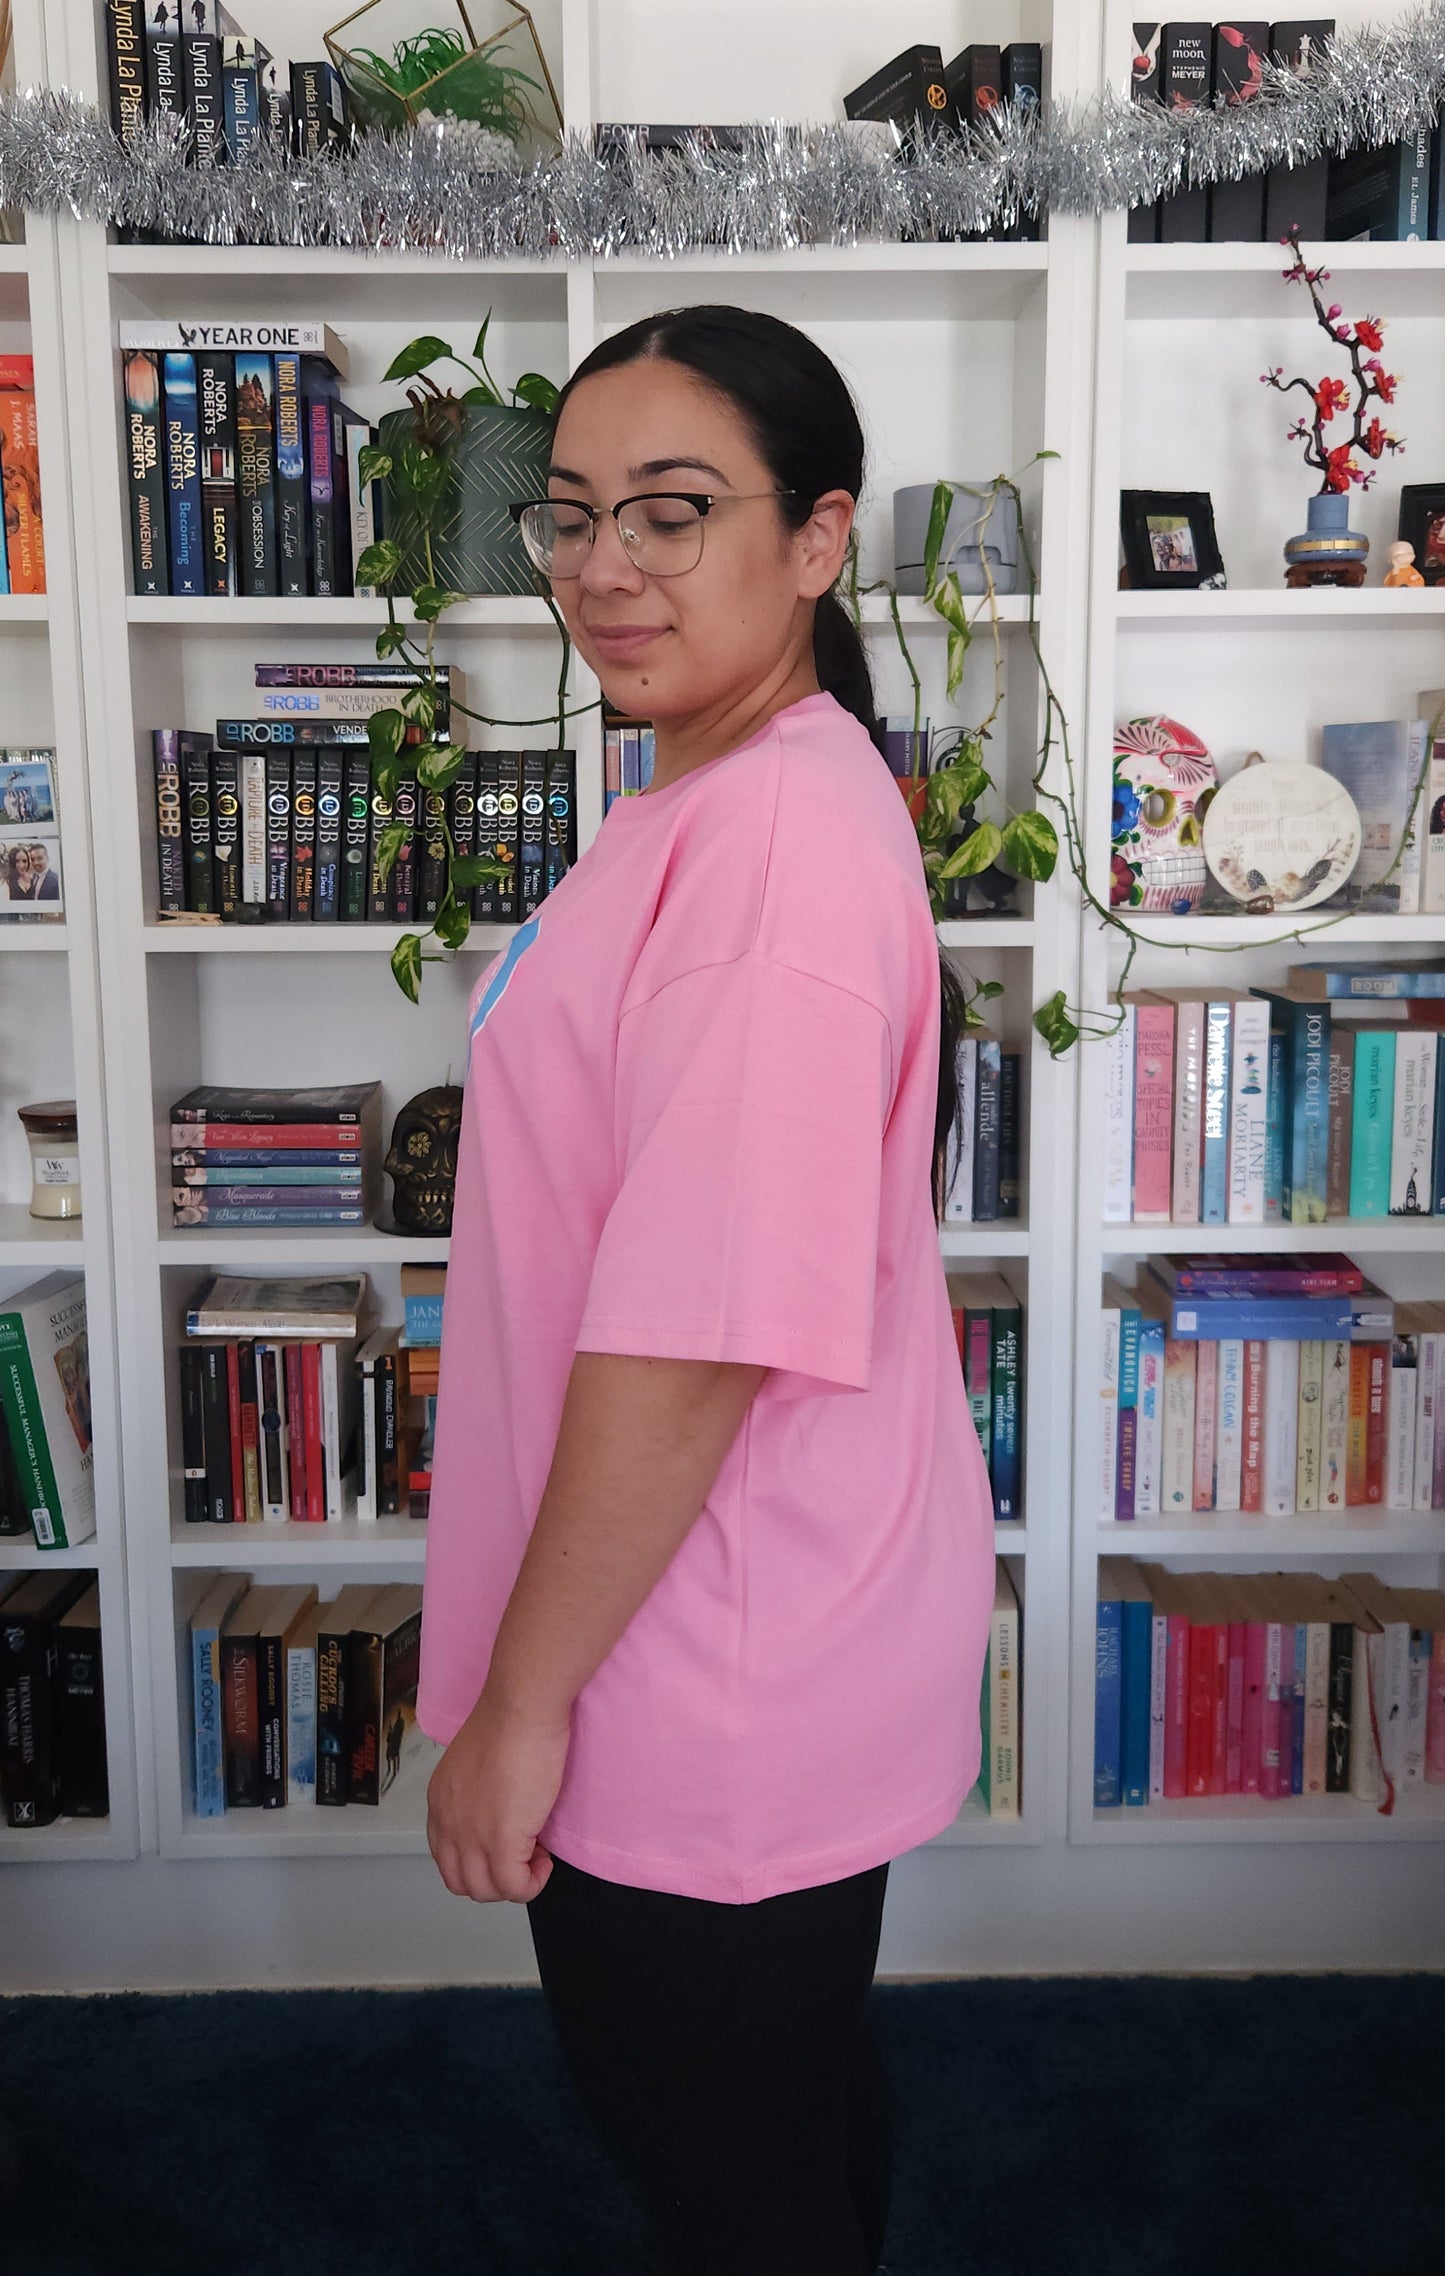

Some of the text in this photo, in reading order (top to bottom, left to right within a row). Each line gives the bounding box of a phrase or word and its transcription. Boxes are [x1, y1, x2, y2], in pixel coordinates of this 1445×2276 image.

[117, 56, 141, 78] La
[153, 42, 175, 87] Lynda
[1172, 49, 1207, 61] moon
[1178, 39, 1202, 48] new
[158, 89, 176, 107] La
[189, 42, 213, 114] Lynda La
[302, 70, 319, 119] Lynda La
[1171, 70, 1206, 79] MEYER
[232, 78, 249, 137] Lynda La
[266, 93, 281, 127] Lynda
[199, 328, 253, 346] YEAR
[257, 328, 300, 346] ONE
[25, 402, 39, 449] SARAH
[202, 367, 216, 436] ROBERTS
[214, 380, 228, 423] NORA
[277, 360, 299, 448] NORA ROBERTS
[12, 411, 26, 450] MAAS
[130, 413, 146, 480] ROBERTS
[144, 425, 158, 469] NORA
[168, 420, 184, 491] ROBERTS
[182, 431, 197, 480] NORA
[311, 405, 330, 478] NORA ROBERTS
[239, 433, 257, 498] ROBERTS
[256, 446, 270, 487] NORA
[137, 493, 154, 571] AWAKENING
[177, 501, 192, 566] Becoming
[212, 507, 228, 564] LEGACY
[251, 505, 265, 569] OBSESSION
[356, 511, 369, 532] KEY
[297, 666, 357, 686] ROBB
[325, 694, 398, 705] BROTHERHOOD
[273, 696, 320, 711] ROBB
[338, 703, 349, 712] IN
[241, 723, 296, 743] ROBB
[157, 774, 181, 838] ROBB
[187, 781, 211, 844] ROBB
[215, 780, 238, 843] ROBB
[246, 775, 264, 865] RAPTURE DEATH
[268, 780, 291, 843] ROBB
[294, 780, 316, 842] ROBB
[319, 780, 341, 842] ROBB
[346, 782, 369, 845] ROBB
[452, 781, 475, 843] ROBB
[477, 782, 501, 844] ROBB
[497, 779, 519, 842] ROBB
[522, 780, 545, 842] ROBB
[161, 843, 174, 897] IN DEATH
[173, 847, 184, 892] NAKED
[278, 862, 288, 901] Vengeance
[296, 876, 306, 898] Death
[302, 866, 313, 898] Holiday
[319, 876, 329, 897] Death
[327, 862, 337, 901] Conspiracy
[372, 872, 382, 895] Death
[524, 874, 534, 898] Death
[532, 869, 542, 896] Visions
[1354, 980, 1396, 992] ROOM
[1137, 1043, 1171, 1056] PESSL
[1305, 1013, 1322, 1049] JODI
[1204, 1007, 1231, 1139] Danielle Steel
[1304, 1052, 1322, 1120] PICOULT
[1329, 1054, 1341, 1106] PICOULT
[1339, 1065, 1351, 1095] JODI
[1369, 1046, 1382, 1087] marian
[1420, 1051, 1432, 1089] Woman
[978, 1081, 997, 1142] allende
[1145, 1111, 1160, 1125] IN
[1366, 1088, 1381, 1119] keyes
[1402, 1059, 1418, 1139] marian keyes
[1415, 1103, 1428, 1128] Stole
[1232, 1102, 1249, 1198] MORIARTY
[1248, 1118, 1265, 1182] LIANE
[215, 1209, 240, 1221] Blue
[241, 1209, 277, 1221] Bloods
[1124, 1328, 1137, 1394] EVANOVICH
[995, 1338, 1008, 1440] TATE minutes
[1004, 1330, 1017, 1454] ASHLEY twenty seven
[1222, 1346, 1239, 1429] JENNY COLGAN
[1423, 1394, 1434, 1417] DIARY
[9, 1363, 38, 1467] SUCCESSFUL MANAGER'S
[1121, 1419, 1133, 1457] TWELVE
[1247, 1362, 1262, 1469] Burning the Map
[199, 1641, 213, 1675] SALLY
[266, 1644, 275, 1669] SALLY
[328, 1640, 338, 1705] CUCKOO'S
[1095, 1626, 1109, 1679] JOHNS
[201, 1678, 214, 1731] ROONEY
[232, 1656, 250, 1735] SILKWORM
[290, 1654, 303, 1710] THOMAS
[301, 1662, 313, 1701] ROSIE
[319, 1654, 330, 1713] CALLING
[999, 1622, 1010, 1736] LESSONS CHEMISTRY
[264, 1723, 274, 1775] WITH FRIENDS
[272, 1717, 281, 1780] CONVERSATIONS
[364, 1723, 377, 1773] CAREER
